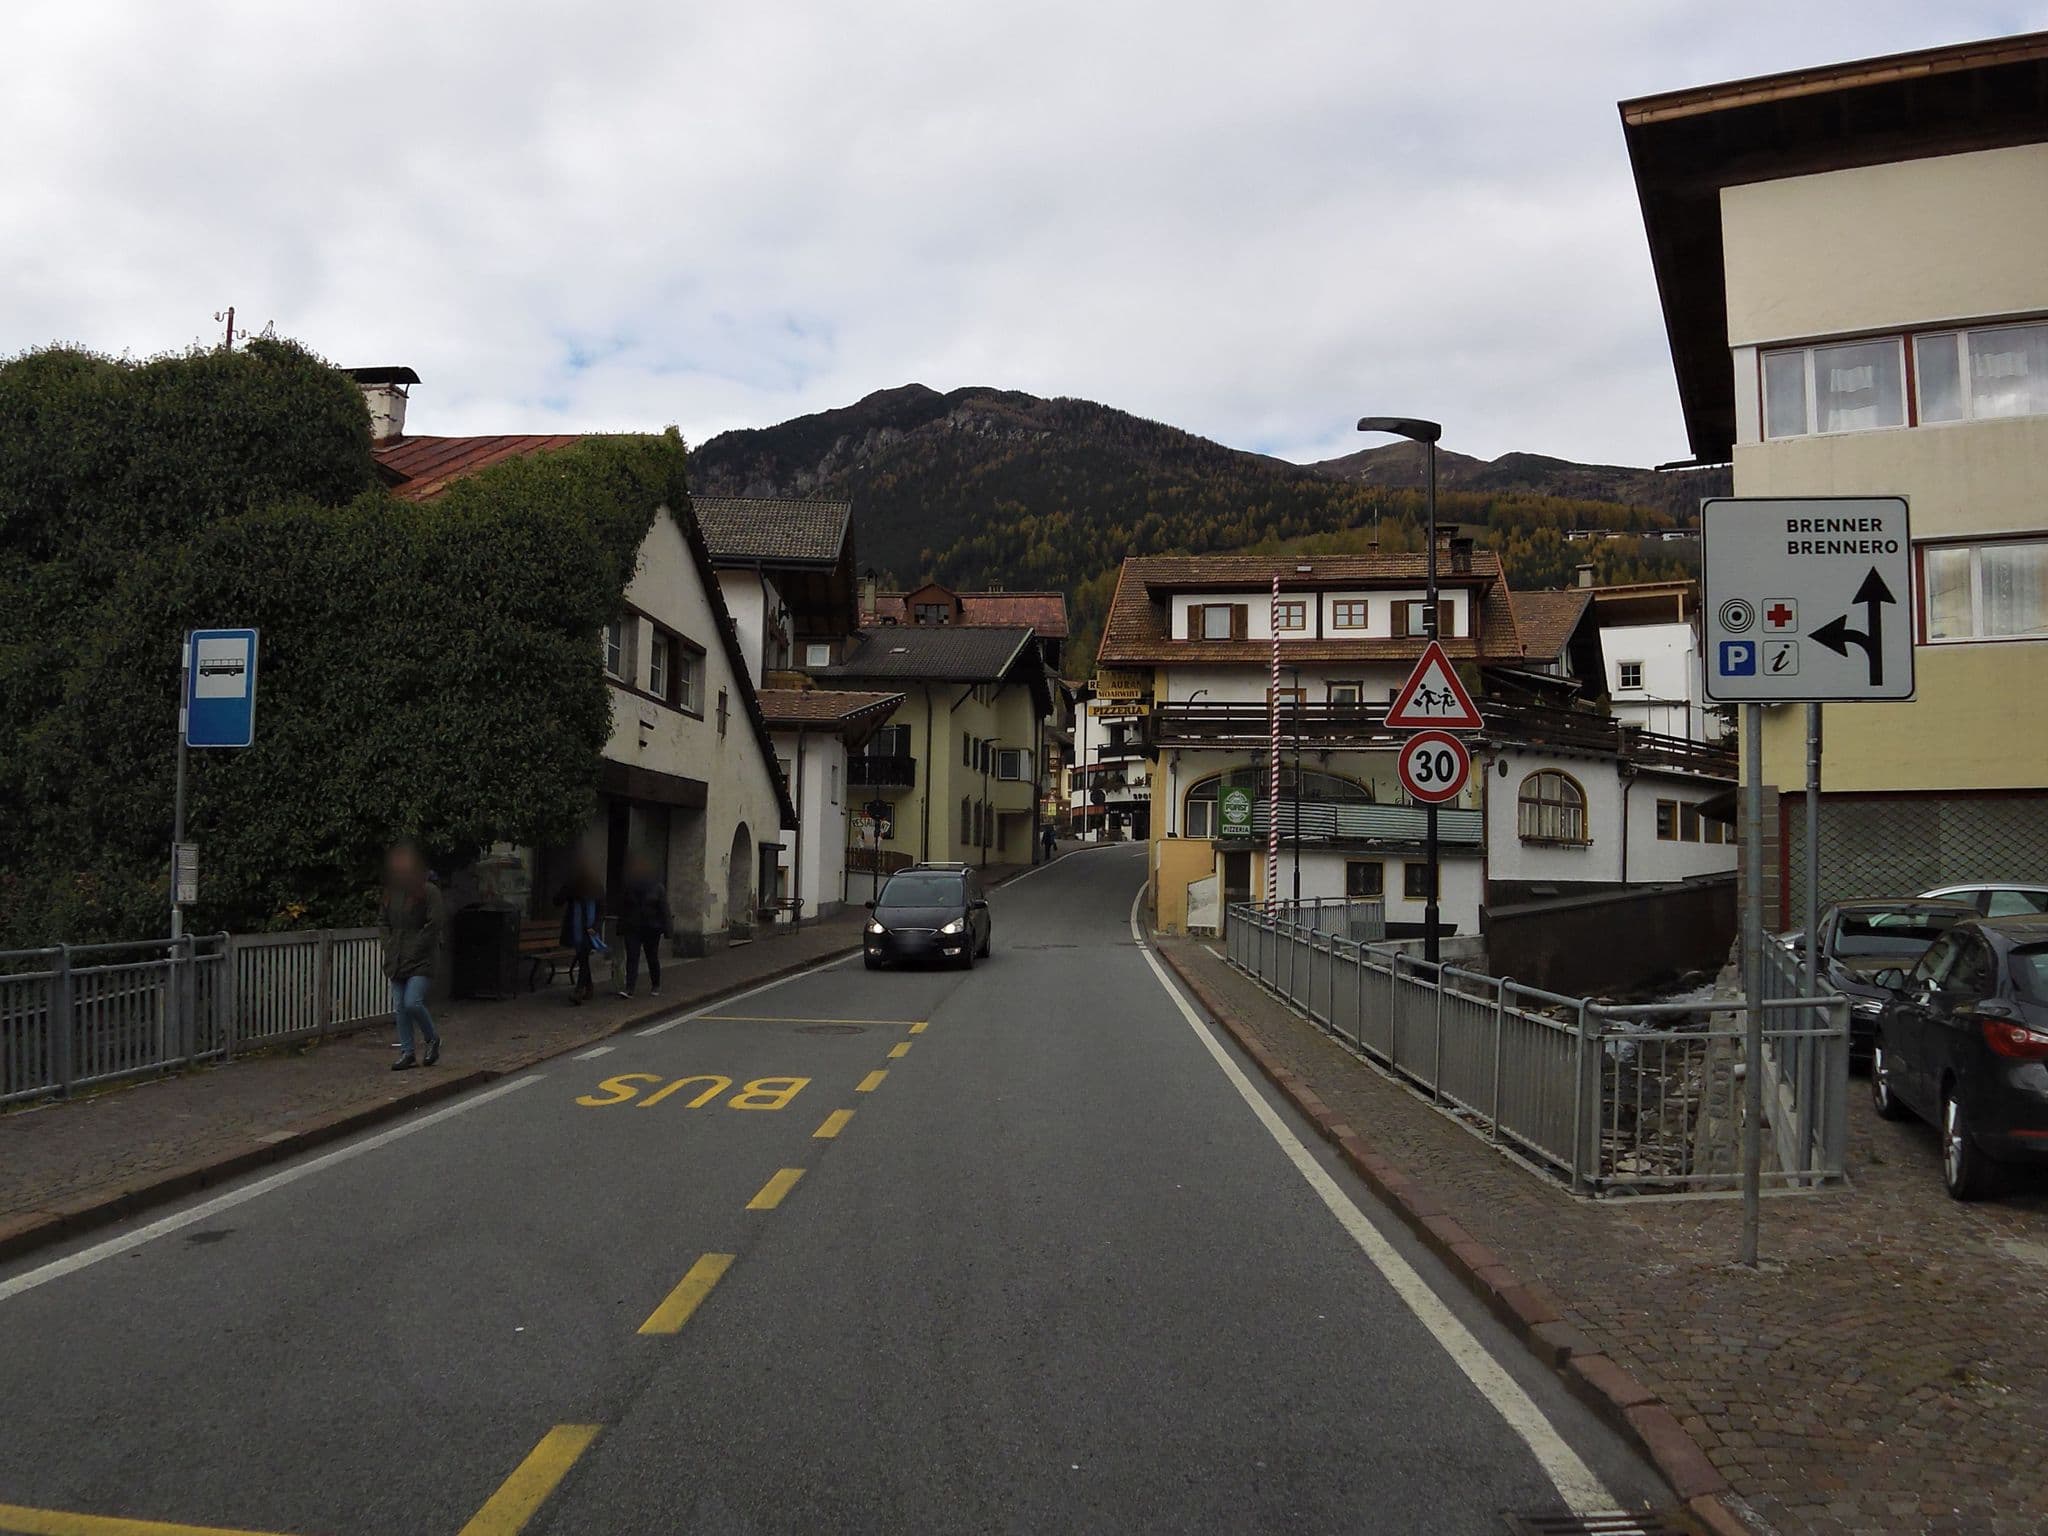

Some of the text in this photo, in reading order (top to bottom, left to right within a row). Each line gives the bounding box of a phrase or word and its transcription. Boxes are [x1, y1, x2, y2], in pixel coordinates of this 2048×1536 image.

[1787, 518, 1883, 533] BRENNER
[1787, 540, 1899, 555] BRENNERO
[1727, 645, 1749, 672] P
[1093, 705, 1144, 715] PIZZERIA
[1415, 750, 1454, 783] 30
[851, 817, 890, 832] RESTAUNT
[1223, 825, 1249, 833] PIZZERIA
[575, 1073, 812, 1110] BUS
